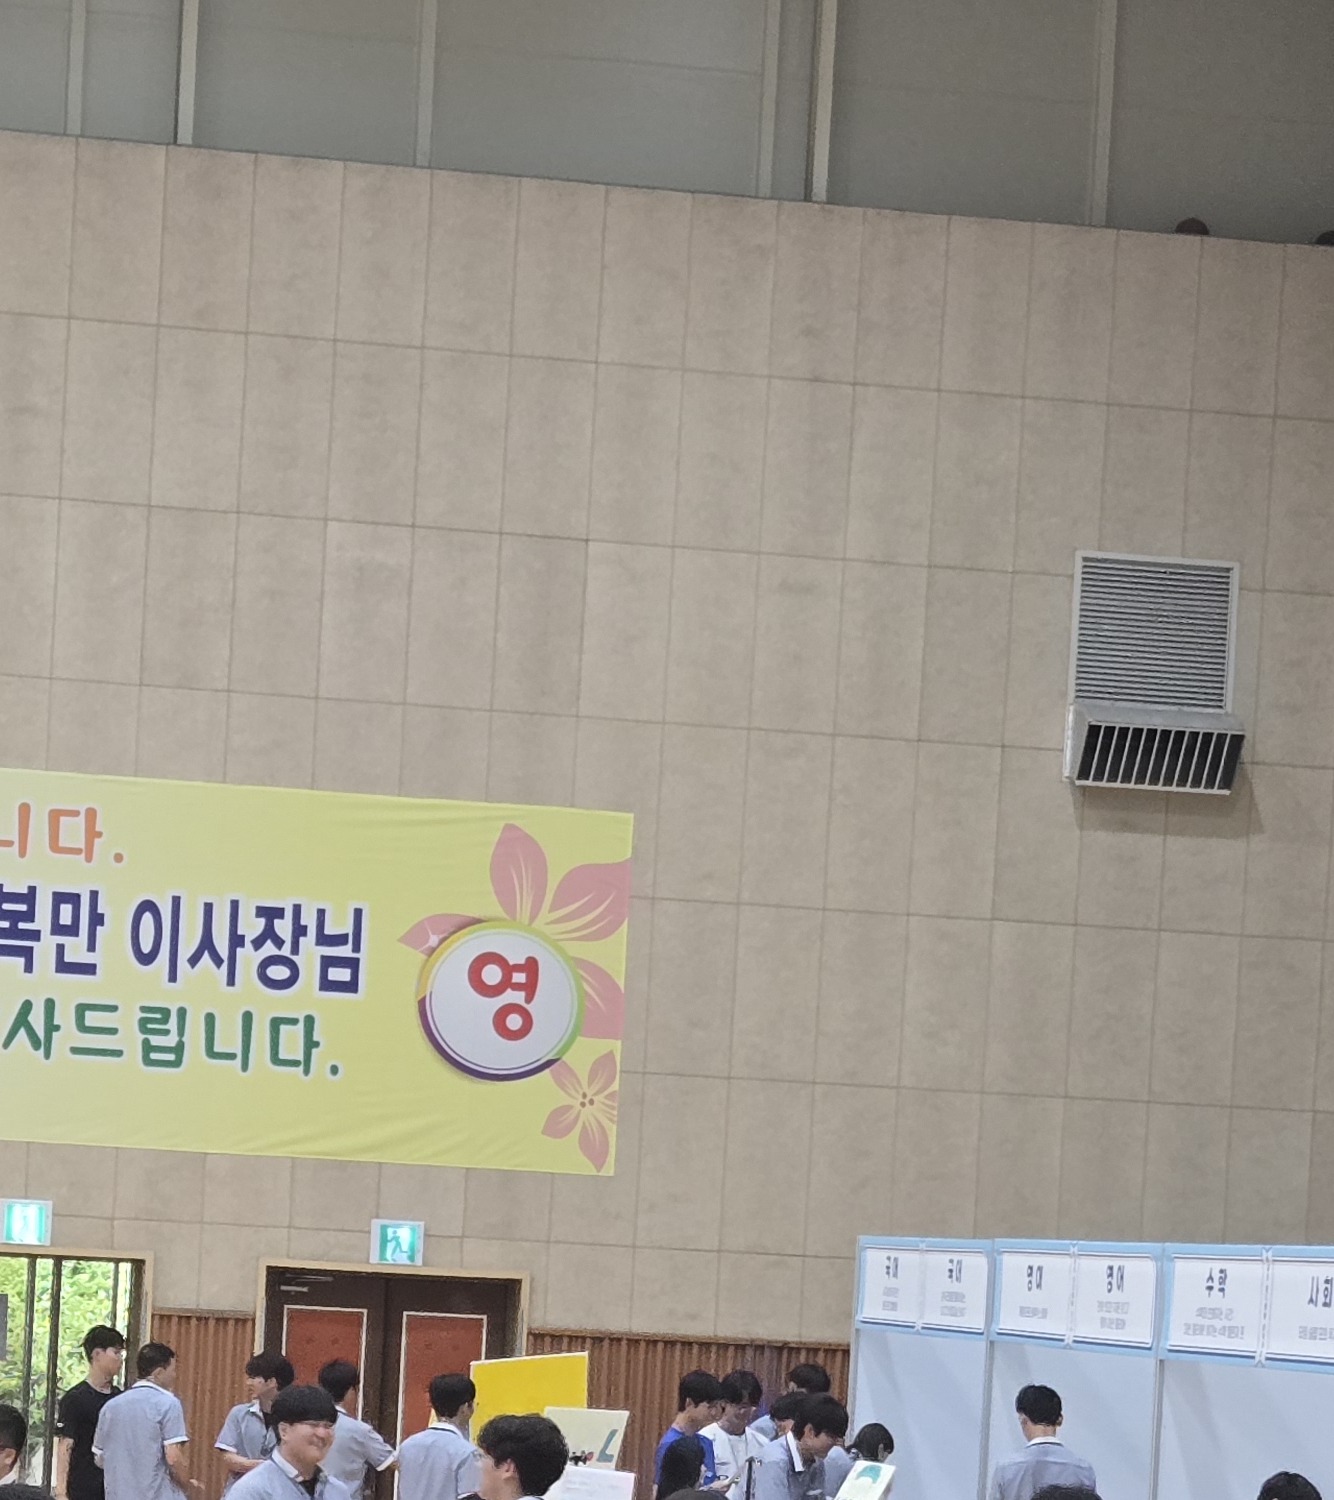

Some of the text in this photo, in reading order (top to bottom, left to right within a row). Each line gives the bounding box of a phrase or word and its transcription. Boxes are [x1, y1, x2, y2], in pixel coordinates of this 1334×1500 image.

[128, 895, 364, 996] 이사장님
[466, 950, 540, 1043] 영
[1026, 1264, 1043, 1292] 영어
[1105, 1264, 1125, 1293] 영어
[1204, 1267, 1228, 1299] 수학
[1307, 1275, 1334, 1308] 사회
